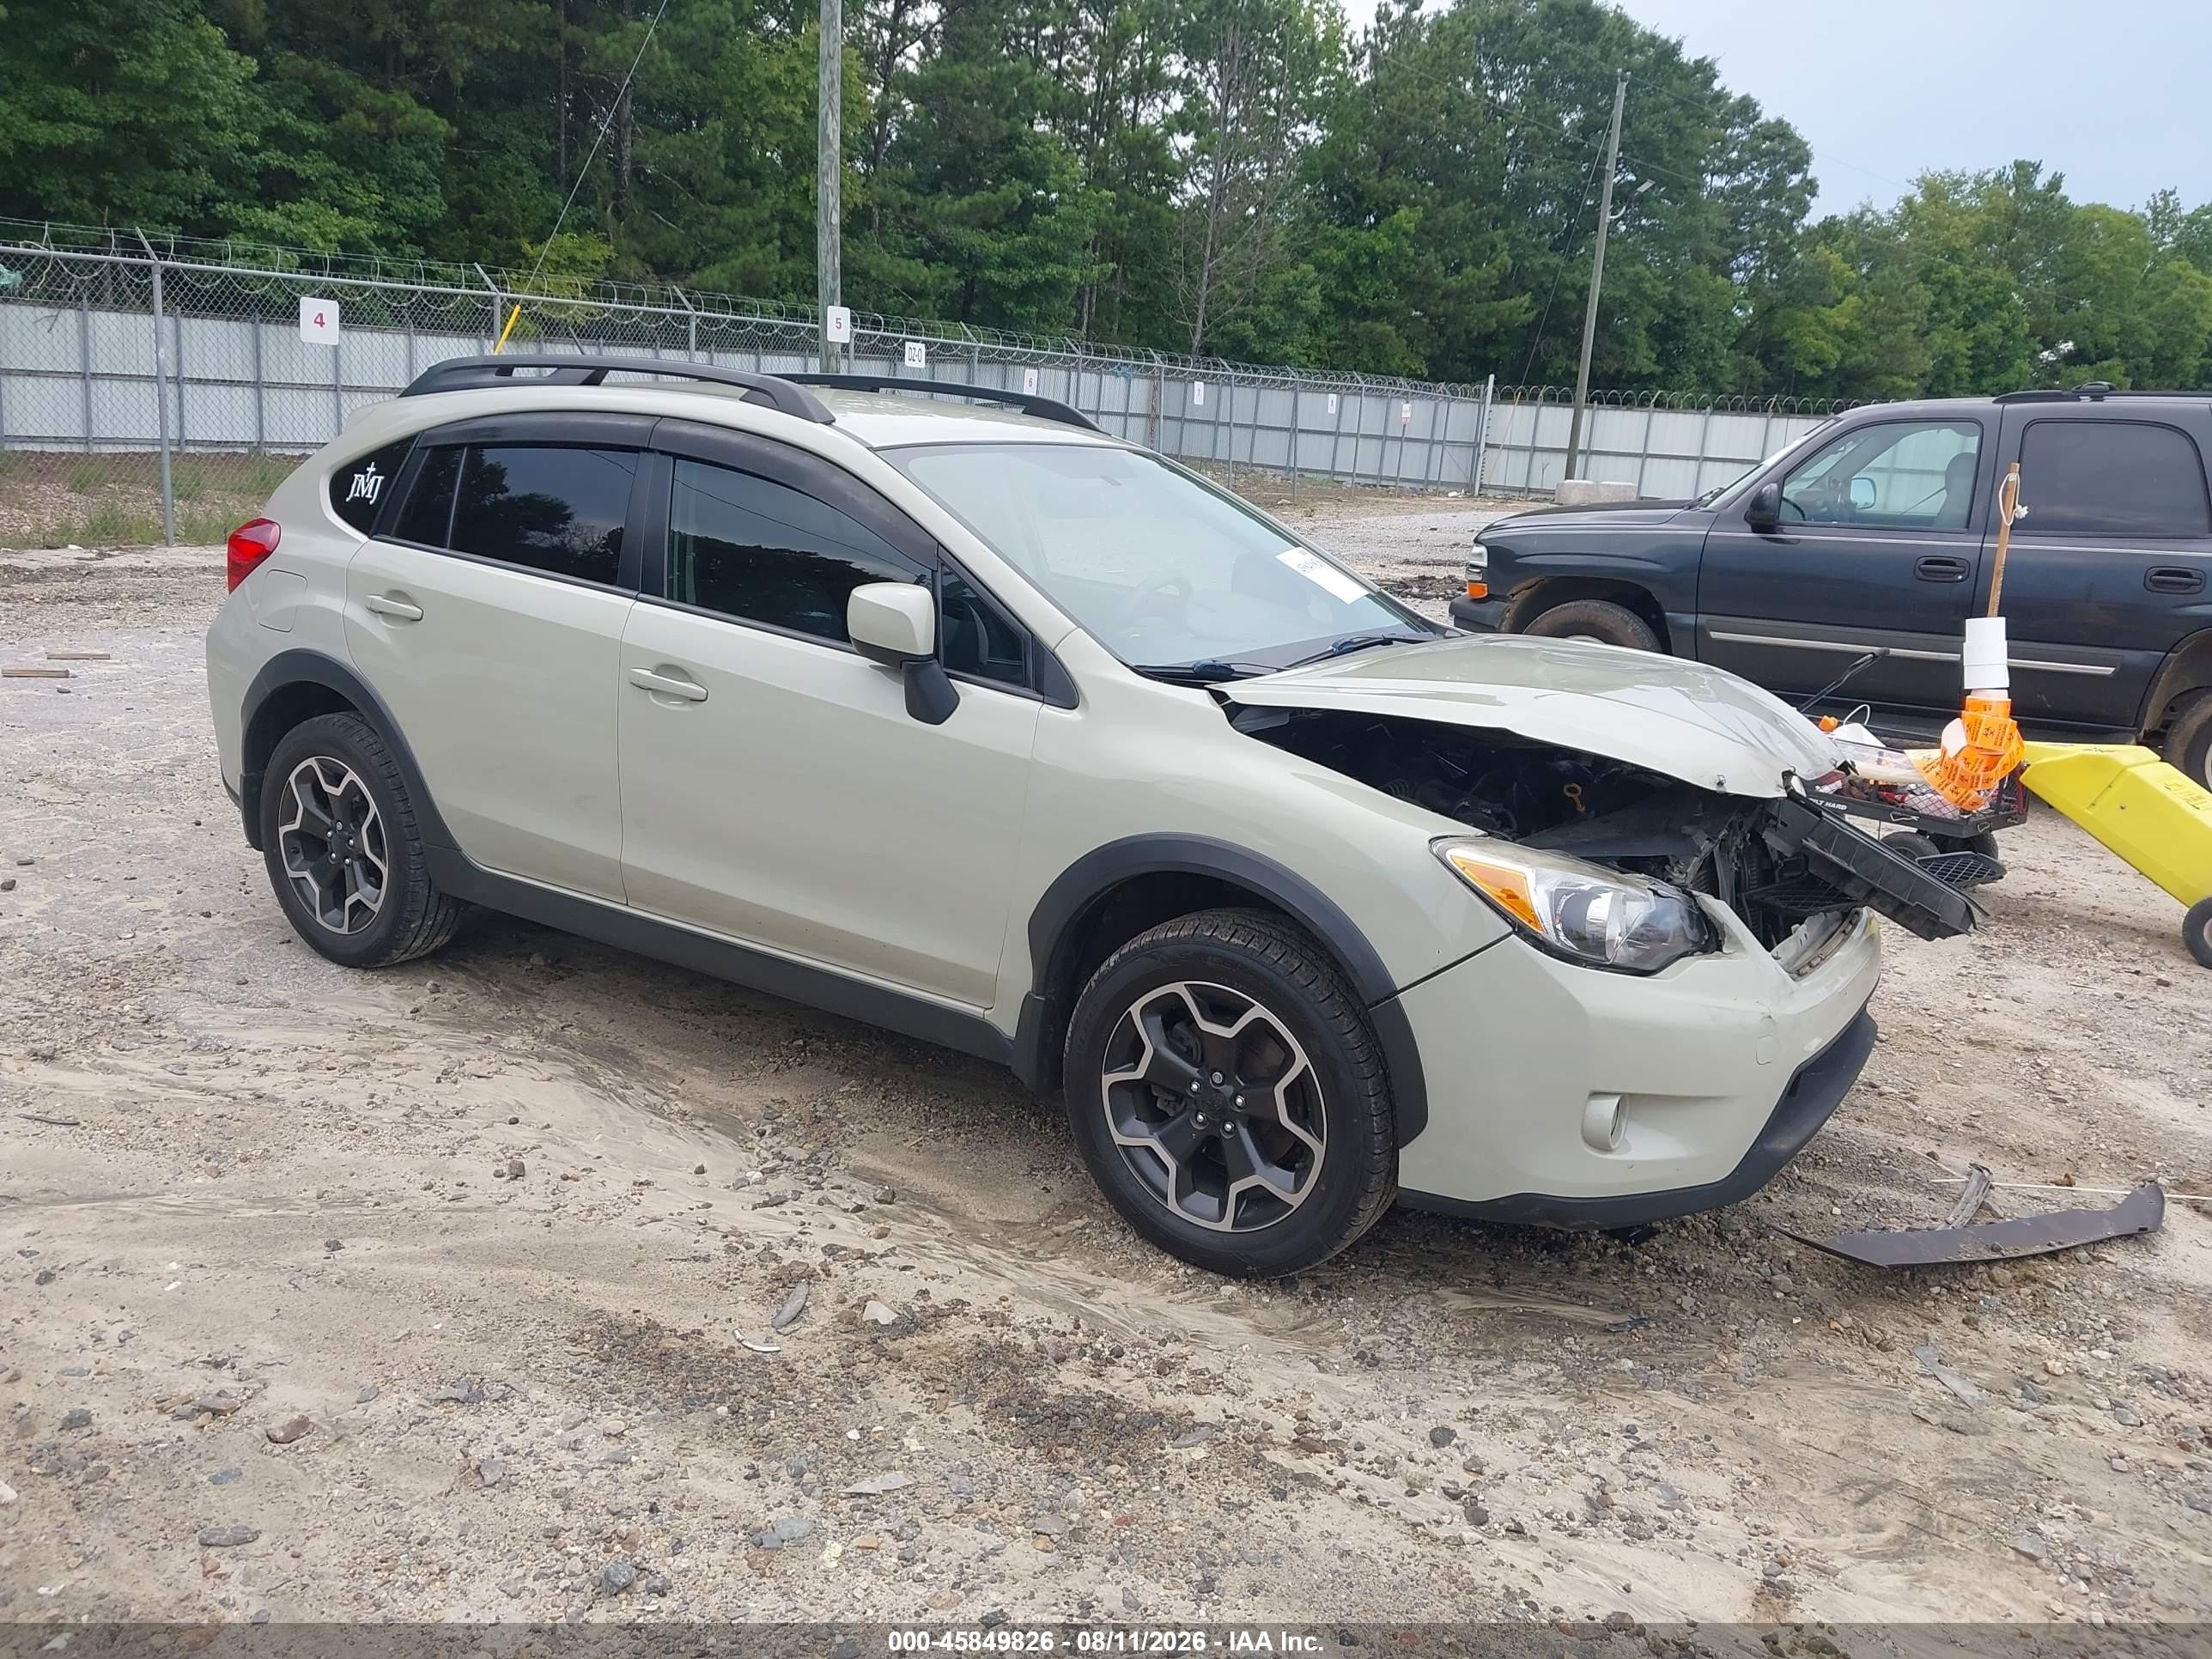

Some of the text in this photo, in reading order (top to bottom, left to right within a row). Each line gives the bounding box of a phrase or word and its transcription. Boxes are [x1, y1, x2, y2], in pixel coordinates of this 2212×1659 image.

[313, 312, 325, 328] 4
[835, 317, 842, 330] 5
[1028, 377, 1033, 387] 6
[345, 473, 385, 505] JMJ
[1824, 801, 1848, 811] HARD
